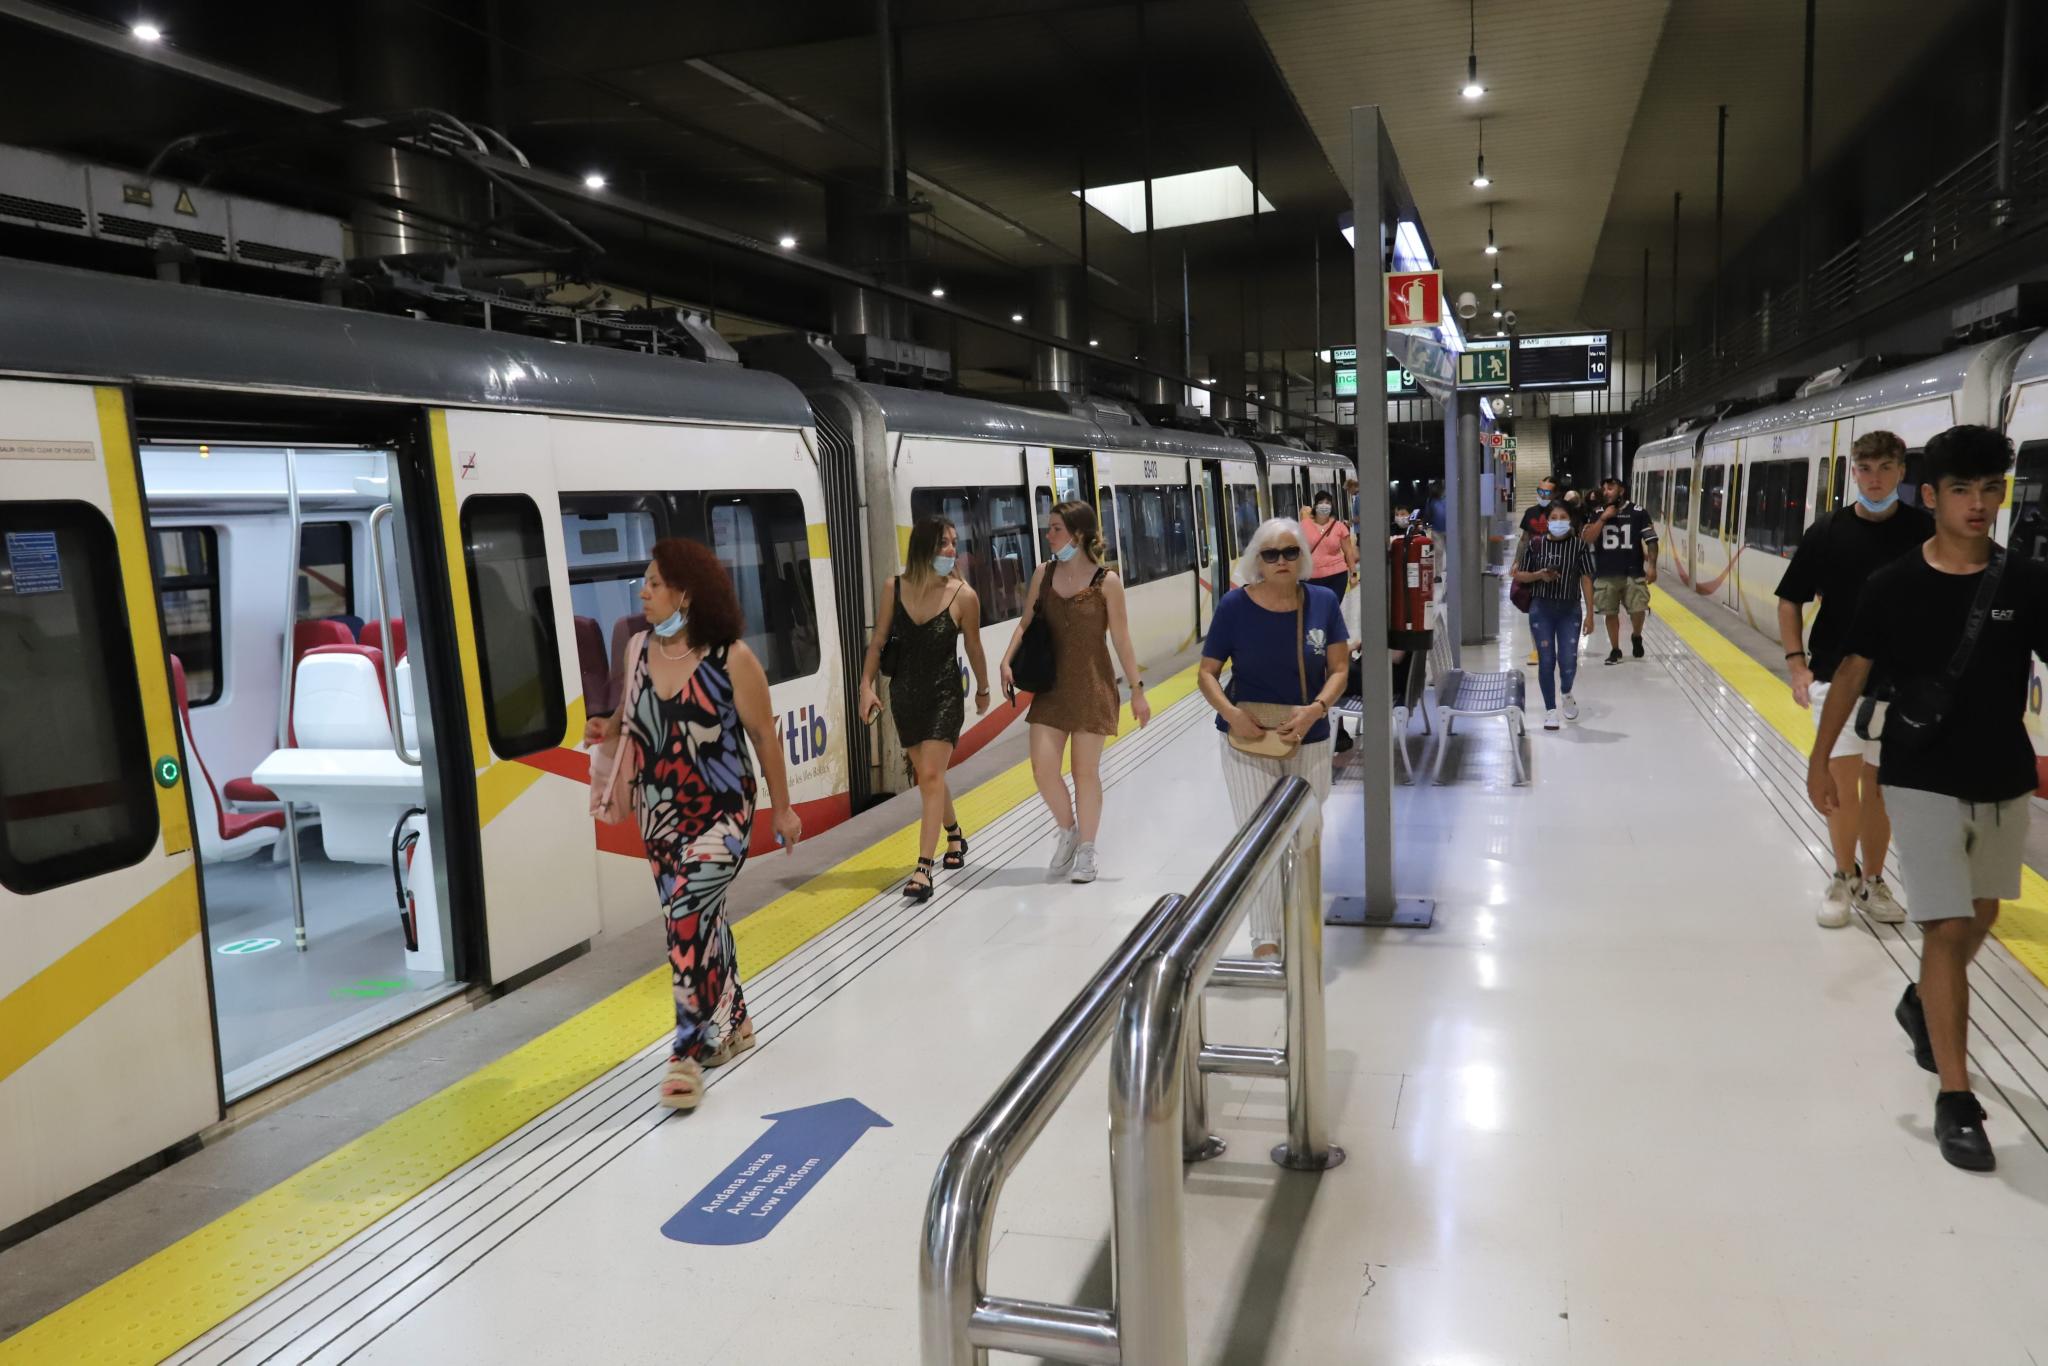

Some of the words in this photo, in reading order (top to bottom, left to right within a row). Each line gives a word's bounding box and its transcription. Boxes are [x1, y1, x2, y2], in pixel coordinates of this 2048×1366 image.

[1336, 374, 1357, 384] Inca
[1402, 369, 1415, 386] 9
[1590, 363, 1604, 373] 10
[1602, 524, 1633, 549] 61
[786, 704, 827, 766] tib
[701, 1178, 746, 1213] Andana
[739, 1153, 773, 1176] baixa
[726, 1185, 766, 1215] Andén
[758, 1164, 787, 1184] bajo
[751, 1197, 781, 1217] Low
[773, 1158, 821, 1195] Platform
